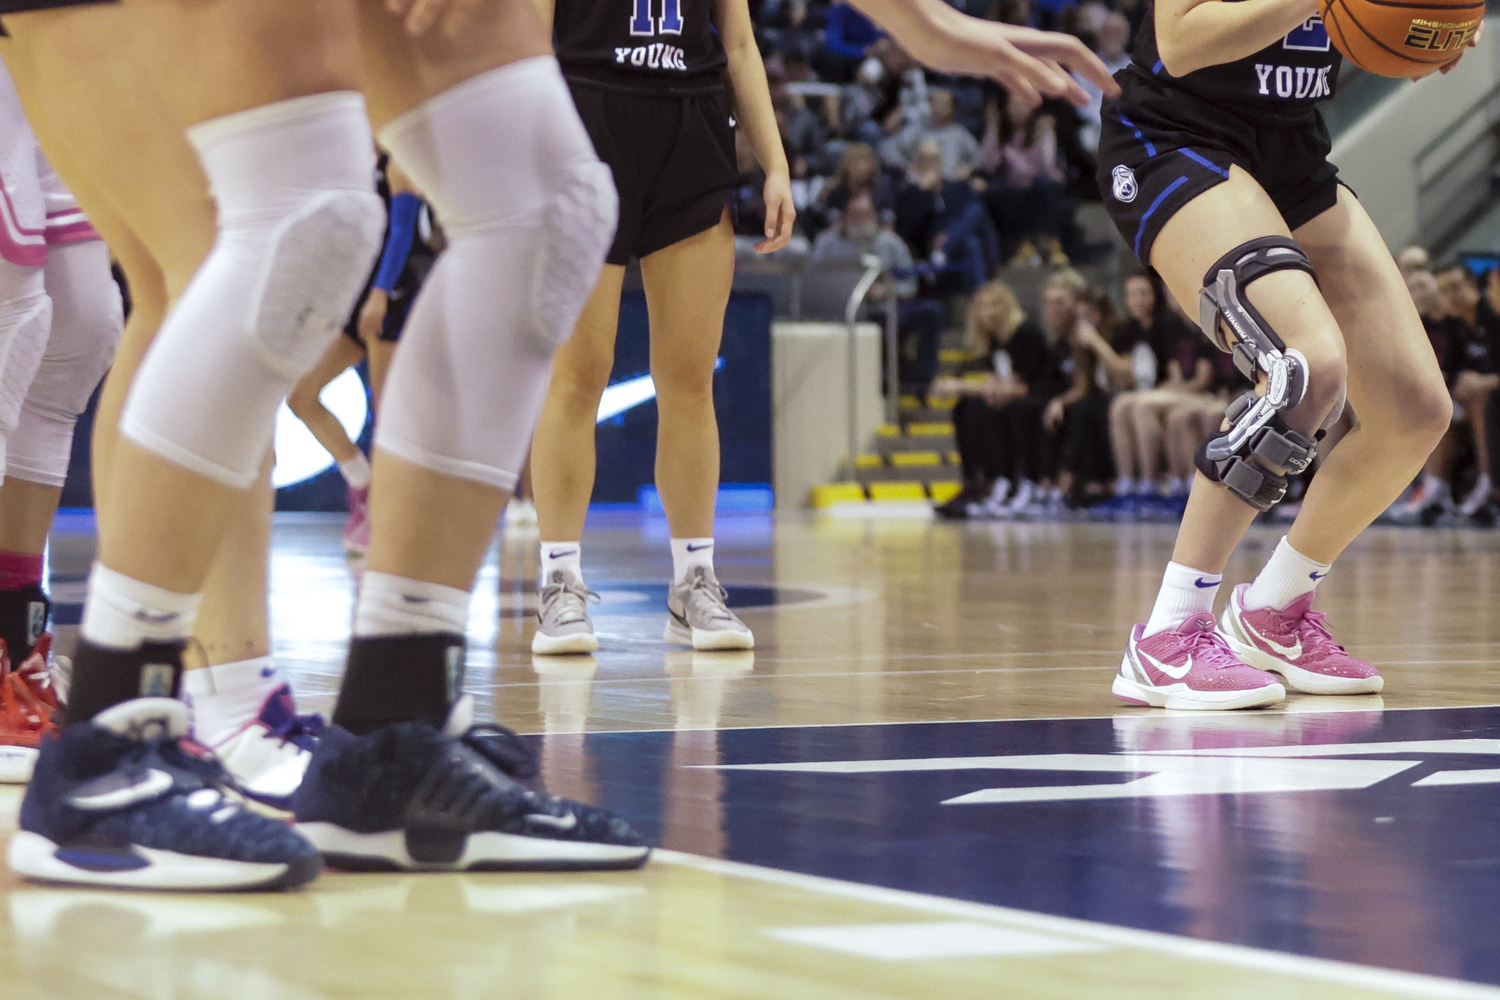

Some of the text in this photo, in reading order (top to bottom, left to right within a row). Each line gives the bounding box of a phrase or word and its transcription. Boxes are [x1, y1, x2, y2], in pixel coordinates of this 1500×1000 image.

[615, 43, 688, 72] YOUNG
[1254, 63, 1333, 99] YOUNG
[1223, 309, 1247, 340] TITANIUM
